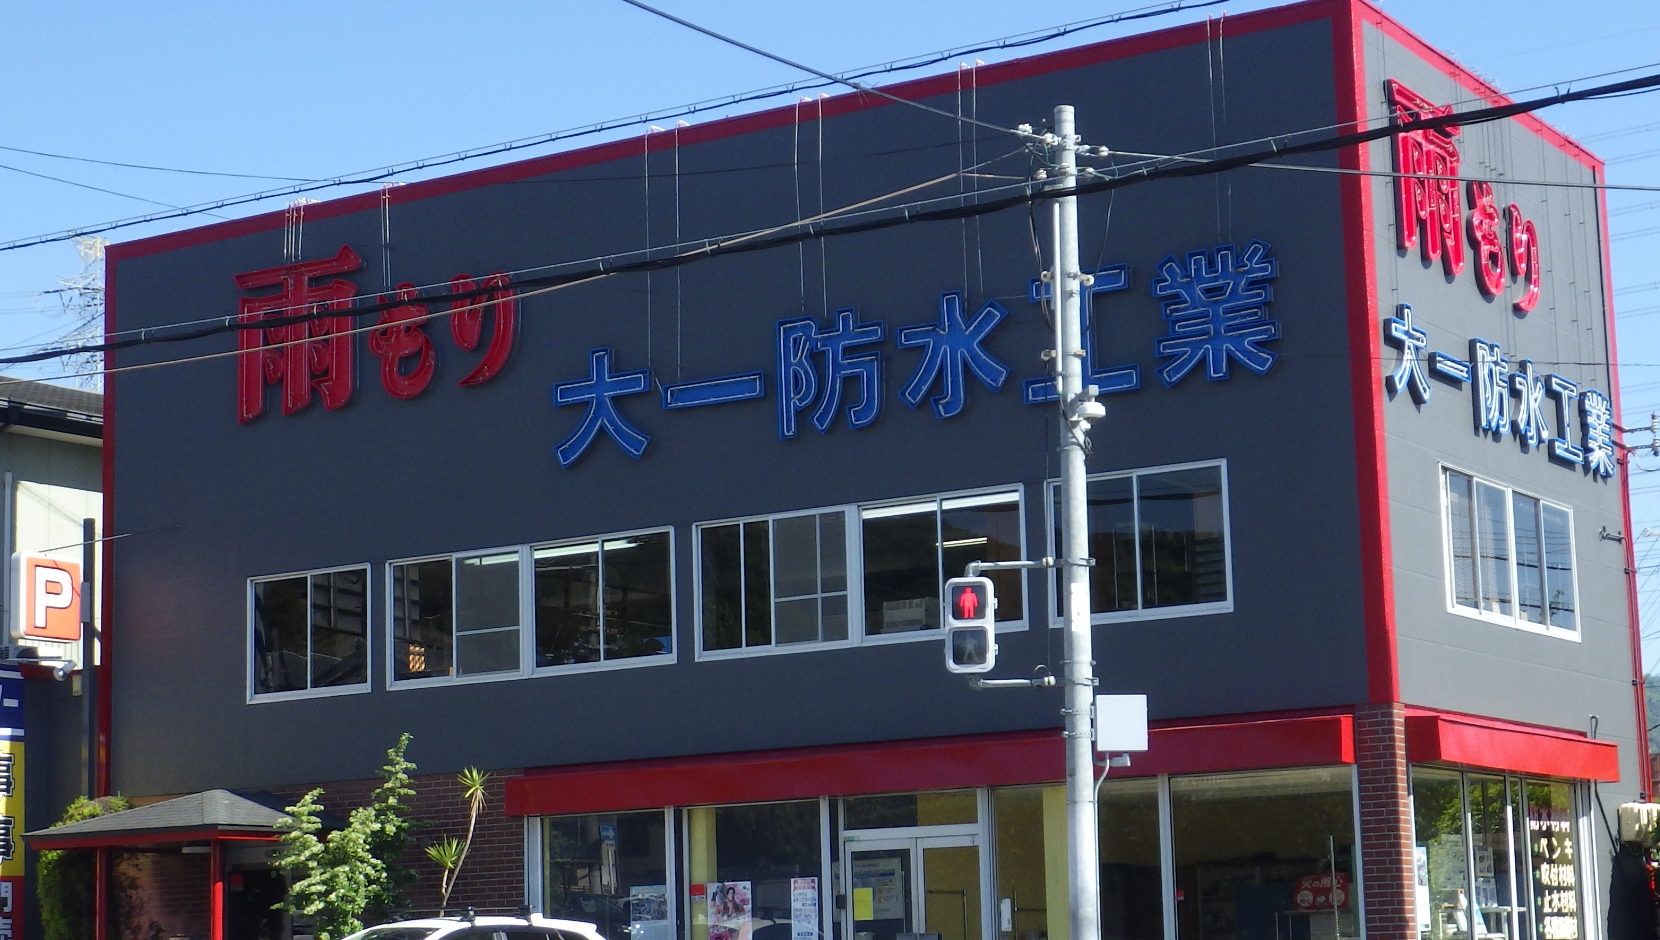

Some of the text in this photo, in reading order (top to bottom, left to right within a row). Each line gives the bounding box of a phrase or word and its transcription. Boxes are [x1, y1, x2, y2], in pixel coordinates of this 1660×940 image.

[1383, 78, 1540, 313] 雨もり
[234, 244, 517, 425] 雨もり
[553, 239, 1281, 468] 大一防水工業
[1384, 303, 1617, 479] 大一防水工業
[33, 565, 73, 629] P
[1540, 837, 1573, 859] ペンキ
